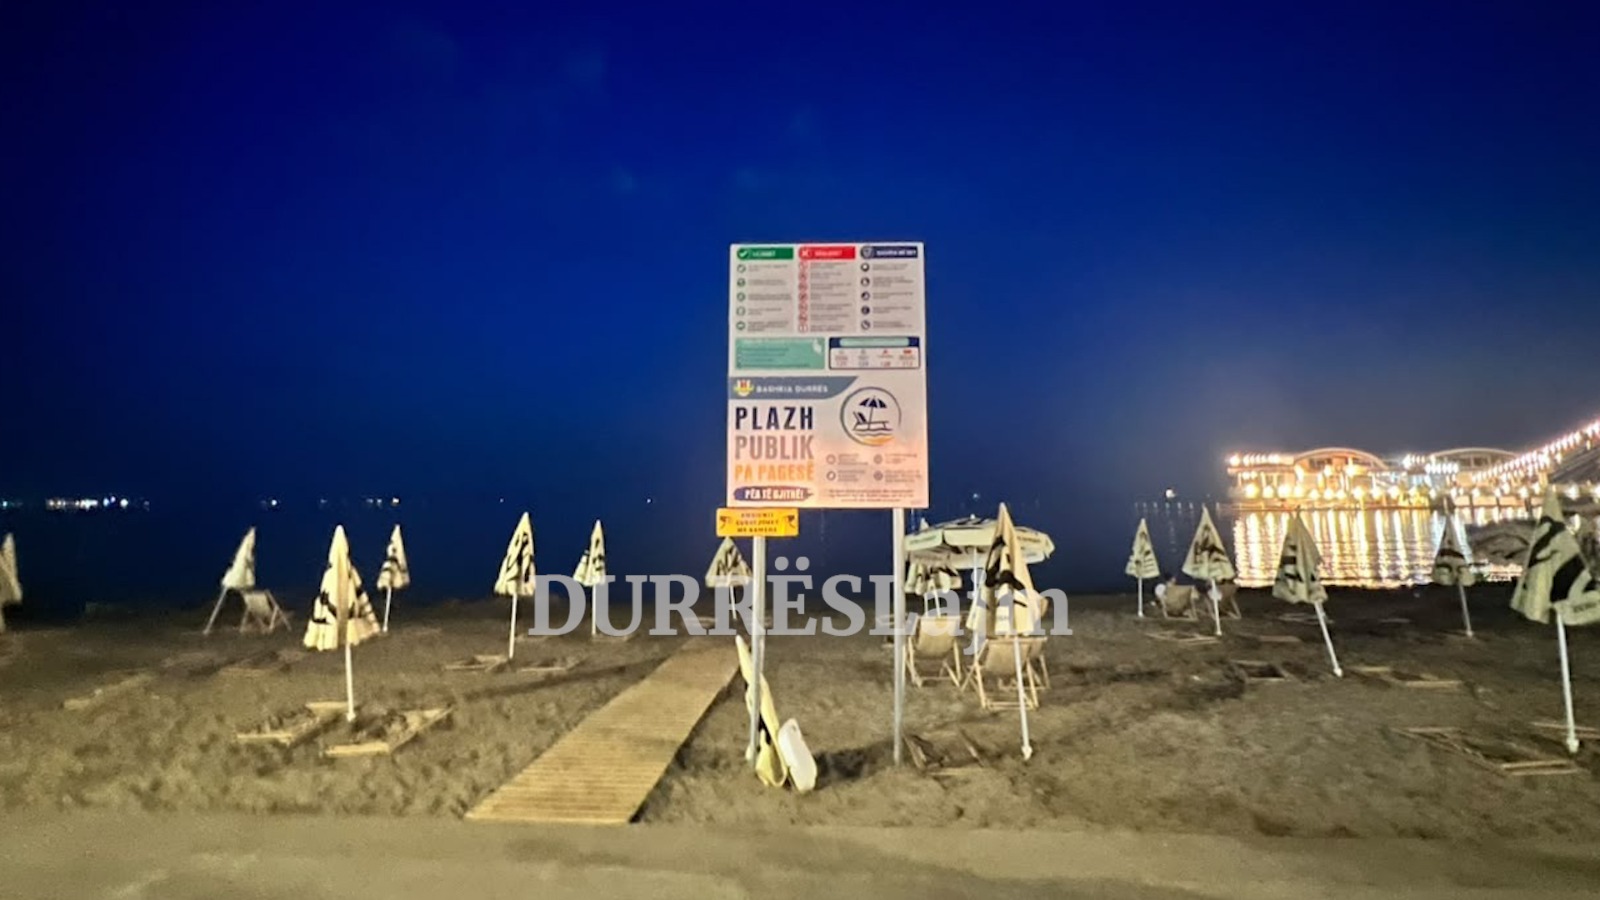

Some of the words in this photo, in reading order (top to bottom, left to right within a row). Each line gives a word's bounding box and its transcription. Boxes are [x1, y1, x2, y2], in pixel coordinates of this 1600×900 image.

[735, 406, 814, 430] PLAZH
[735, 435, 815, 460] PUBLIK
[735, 464, 753, 481] PA
[758, 460, 815, 481] PAGESË
